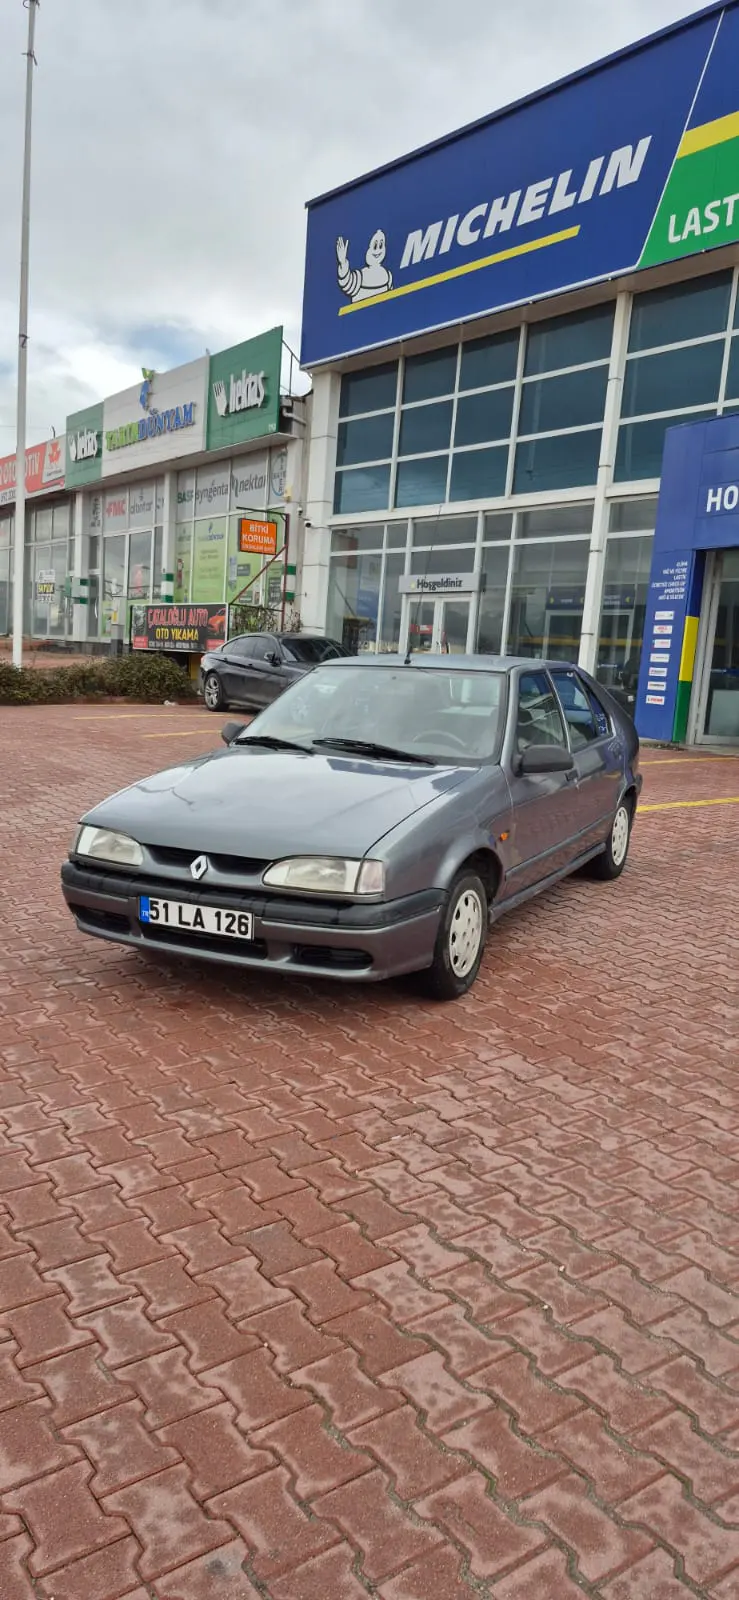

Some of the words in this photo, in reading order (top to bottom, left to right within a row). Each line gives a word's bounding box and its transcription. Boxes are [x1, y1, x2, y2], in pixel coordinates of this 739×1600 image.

[399, 135, 652, 269] MICHELIN
[668, 193, 739, 243] LAST
[706, 485, 738, 512] HO
[242, 533, 275, 545] KORUMA
[416, 577, 463, 591] Hoşgeldiniz
[187, 608, 208, 627] AUTO
[156, 628, 169, 640] OTO
[171, 628, 199, 640] YIKAMA
[149, 900, 169, 922] 51
[178, 905, 206, 929] LA
[214, 910, 249, 936] 126
